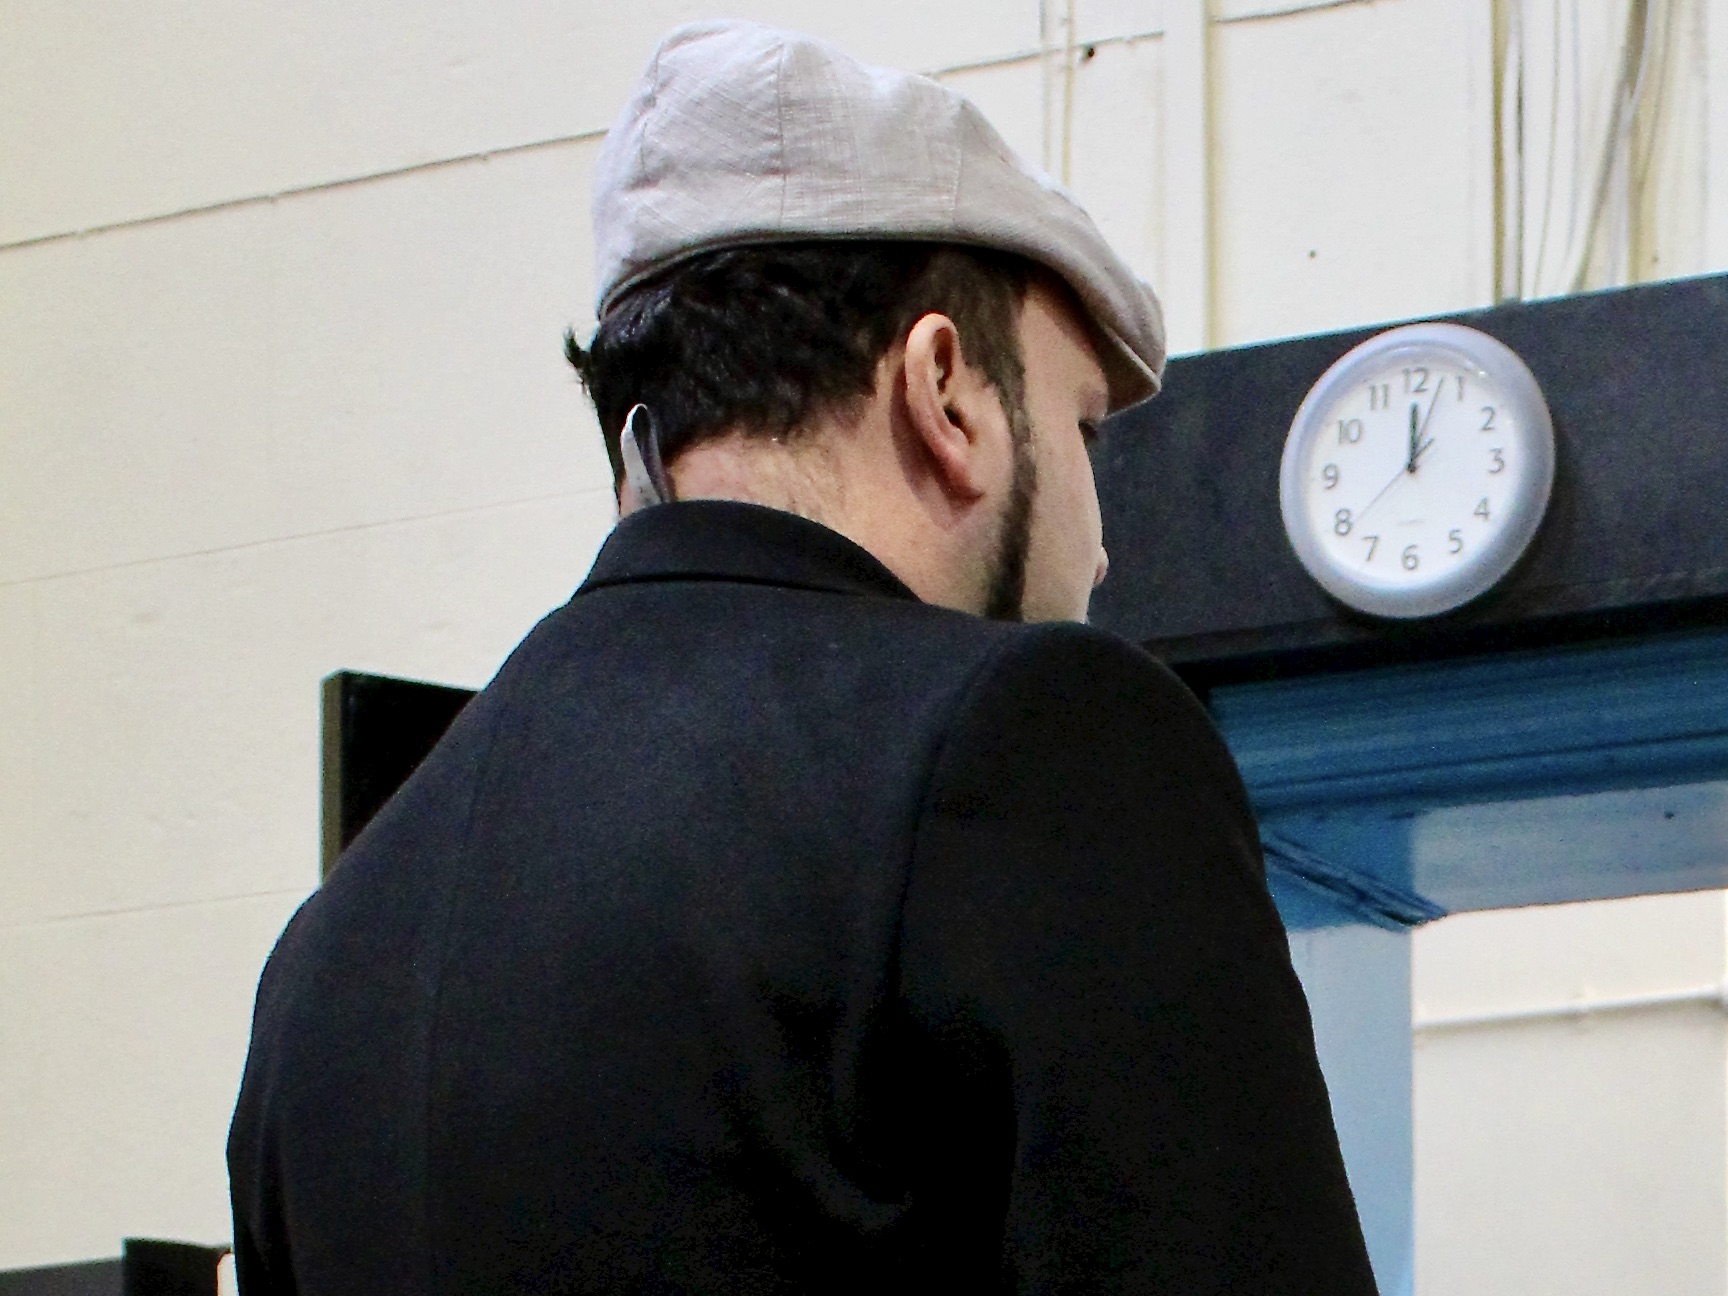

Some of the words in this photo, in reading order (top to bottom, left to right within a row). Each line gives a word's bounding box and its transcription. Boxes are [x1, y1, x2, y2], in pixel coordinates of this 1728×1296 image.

[1403, 367, 1429, 393] 12
[1456, 376, 1465, 402] 1
[1370, 384, 1390, 410] 11
[1338, 418, 1362, 444] 10
[1481, 405, 1496, 431] 2
[1490, 449, 1504, 474] 3
[1323, 464, 1340, 489] 9
[1334, 508, 1353, 536] 8
[1474, 497, 1490, 521] 4
[1362, 535, 1379, 562] 7
[1449, 529, 1463, 554] 5
[1402, 545, 1420, 571] 6
